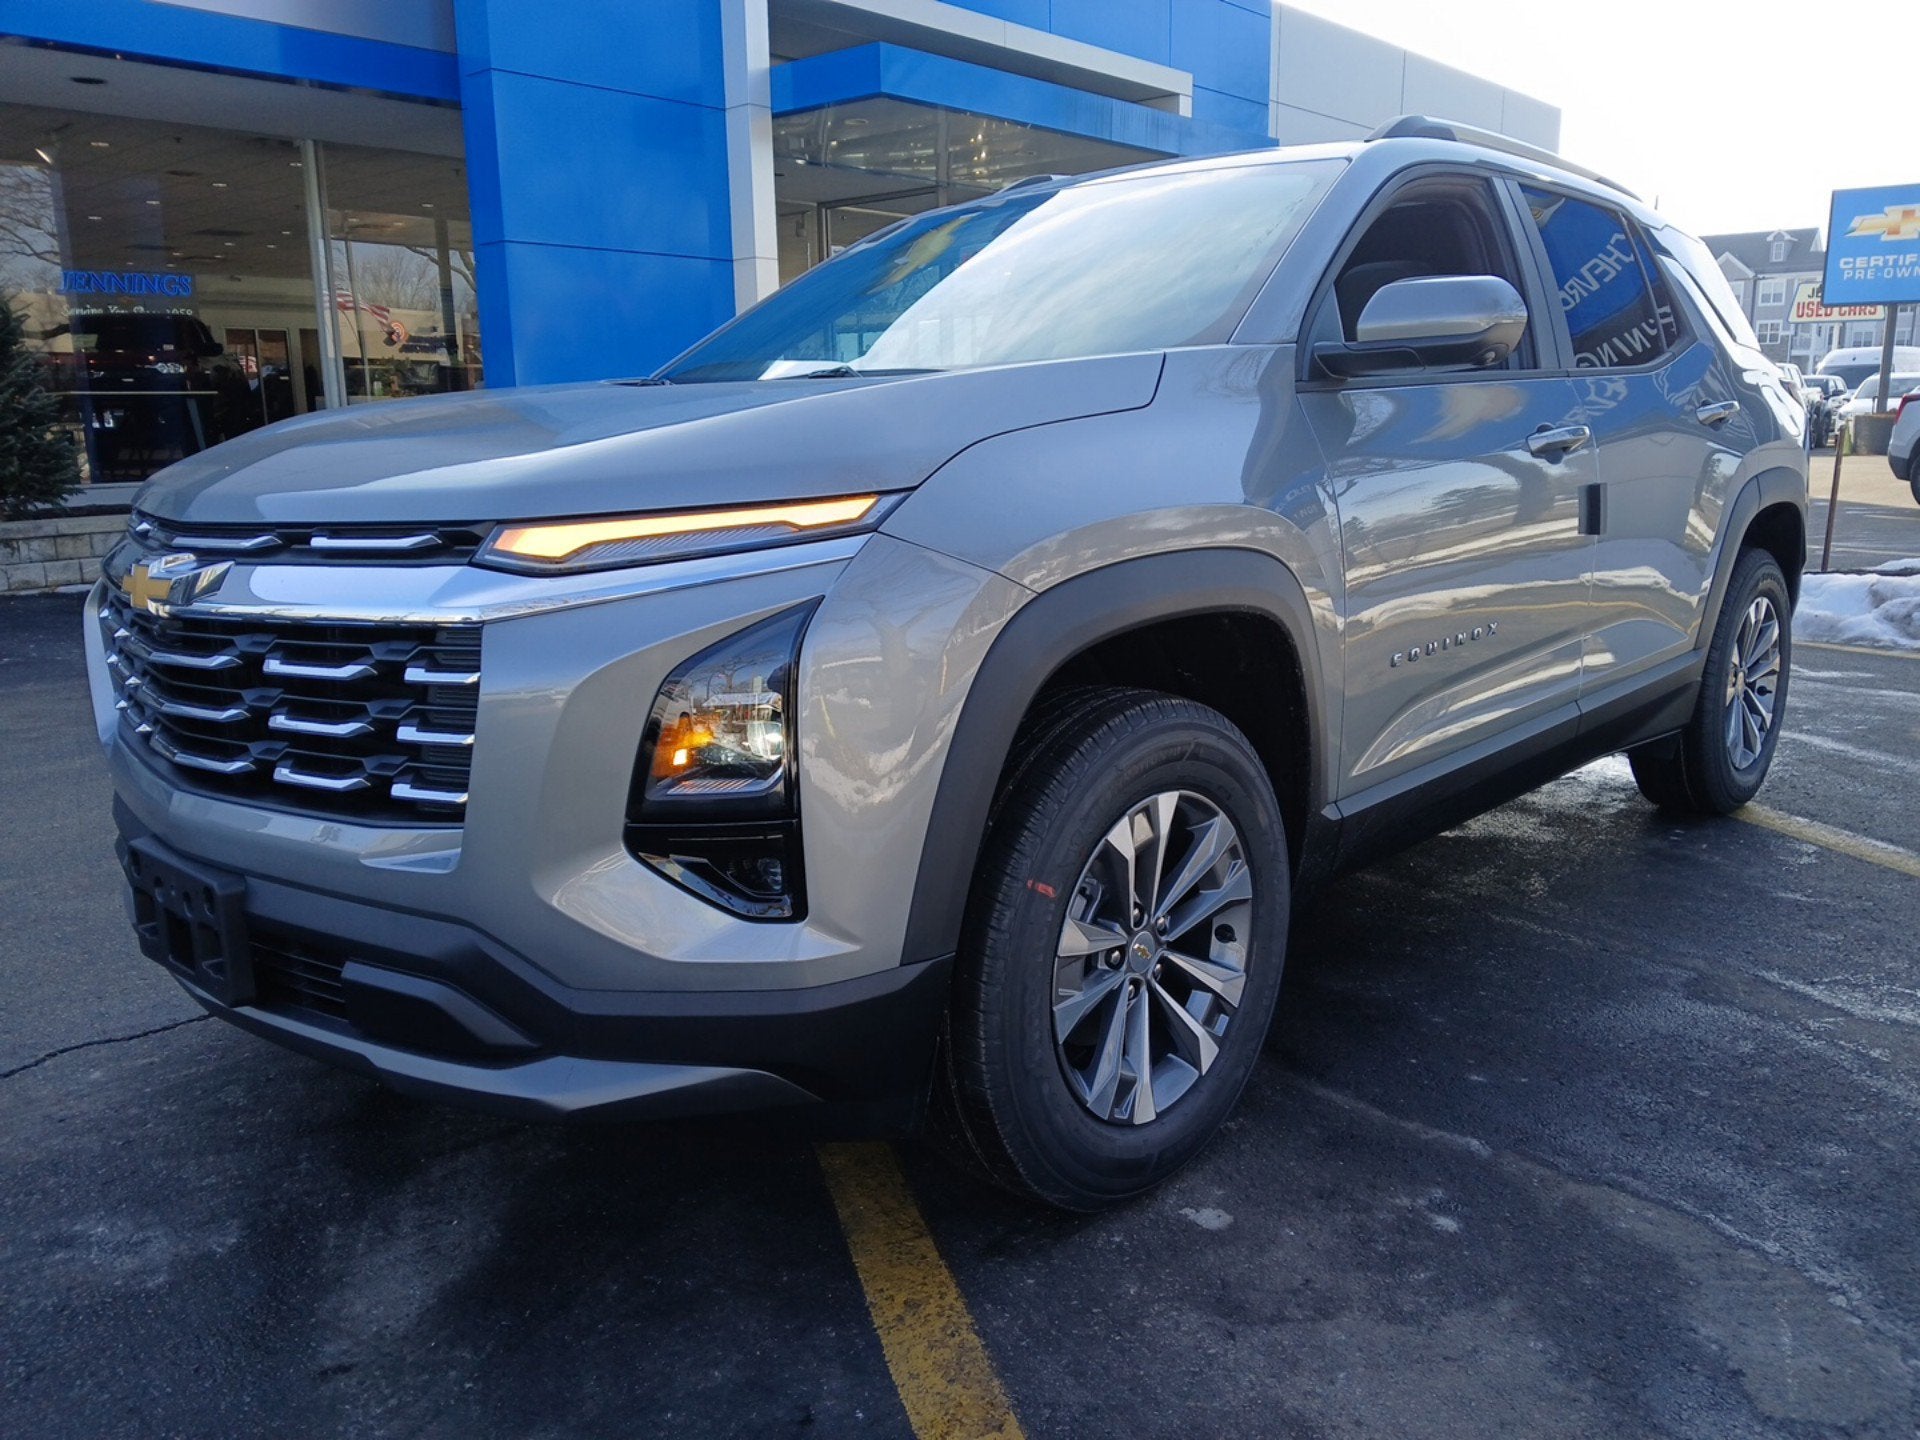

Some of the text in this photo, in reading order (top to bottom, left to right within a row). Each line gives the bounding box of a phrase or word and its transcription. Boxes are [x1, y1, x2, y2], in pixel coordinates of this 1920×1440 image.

[1839, 252, 1919, 269] CERTIF
[57, 271, 192, 297] JENNINGS
[1796, 301, 1877, 318] USED CARS
[1390, 622, 1498, 668] EQUINOX
